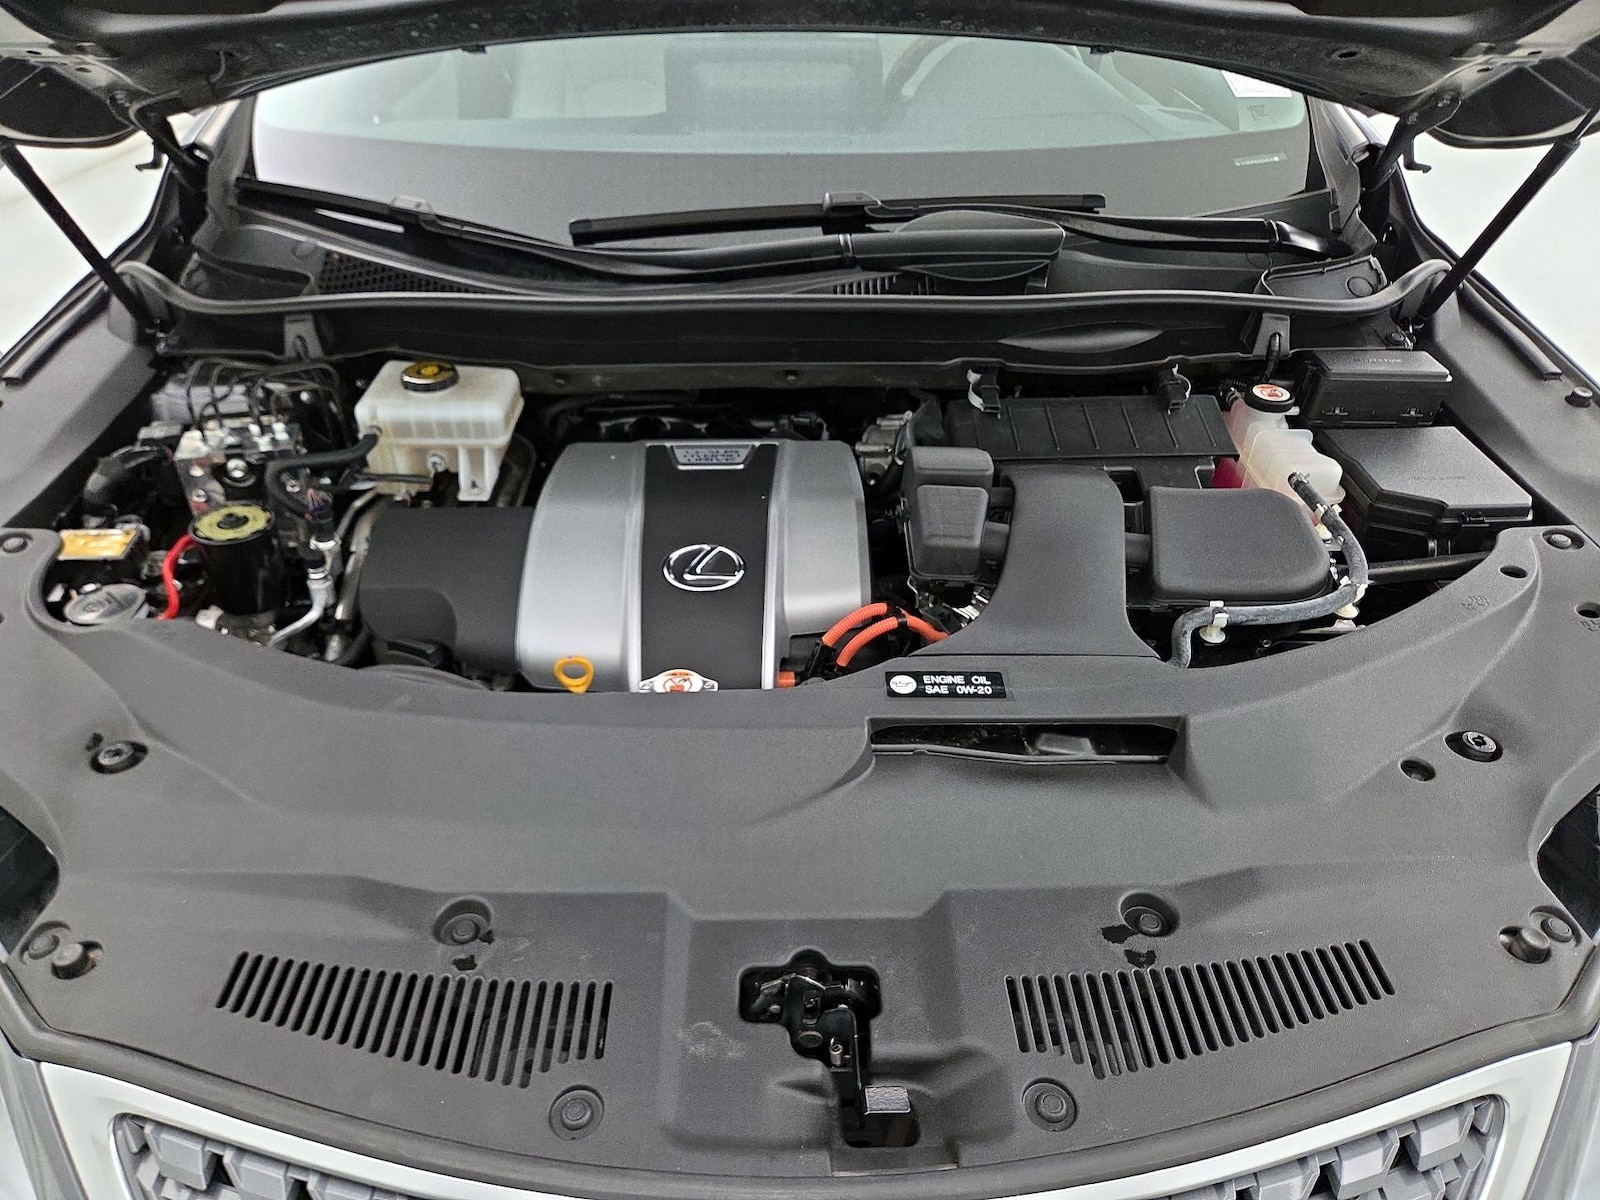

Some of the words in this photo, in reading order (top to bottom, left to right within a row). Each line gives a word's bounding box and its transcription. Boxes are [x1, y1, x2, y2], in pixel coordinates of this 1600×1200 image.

[922, 675, 965, 684] ENGINE
[971, 675, 991, 685] OIL
[925, 685, 949, 694] SAE
[956, 685, 992, 695] 0W-20
